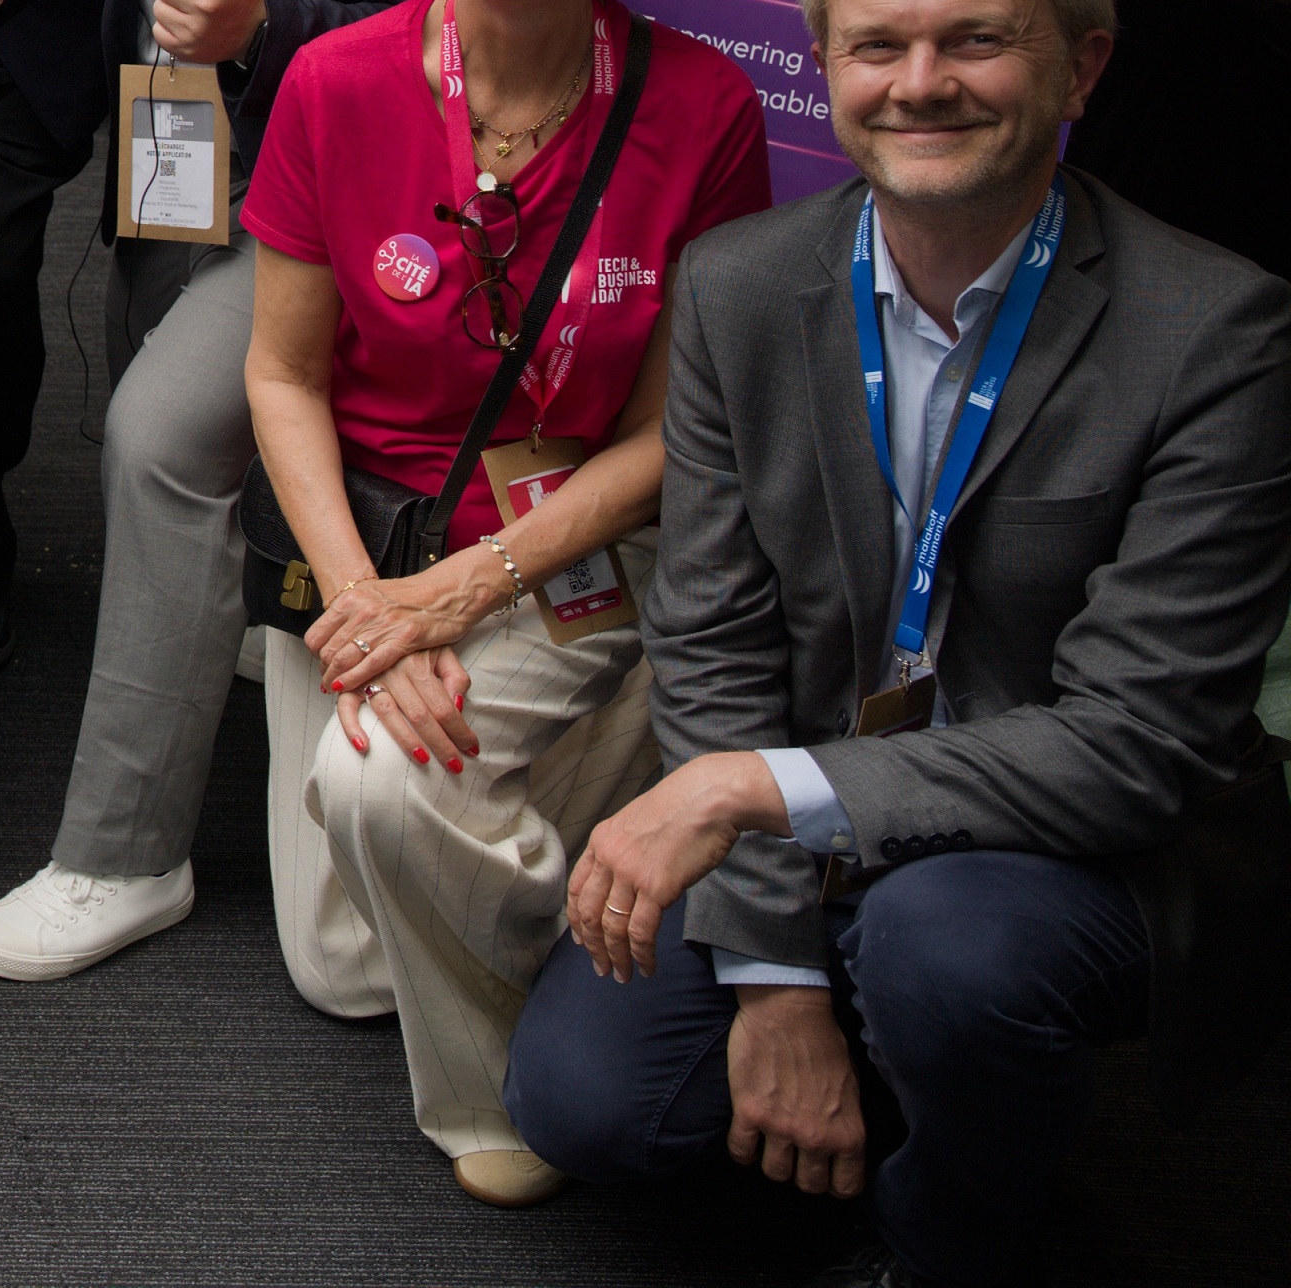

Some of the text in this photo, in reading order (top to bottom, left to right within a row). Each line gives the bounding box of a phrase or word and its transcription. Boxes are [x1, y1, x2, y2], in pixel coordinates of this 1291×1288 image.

[442, 23, 451, 72] malakoff
[450, 20, 462, 71] humanis
[594, 43, 605, 94] humanis
[603, 44, 614, 95] malakoff
[1035, 187, 1057, 238] malakoff
[1044, 194, 1066, 242] humanis
[396, 257, 431, 283] CITÉ
[403, 276, 422, 297] IA
[598, 257, 640, 273] TECH &
[598, 269, 657, 289] BUSINESS
[598, 287, 623, 304] DAY
[552, 349, 574, 390] malakoff
[918, 508, 939, 564] malakoff
[924, 514, 947, 569] humanis
